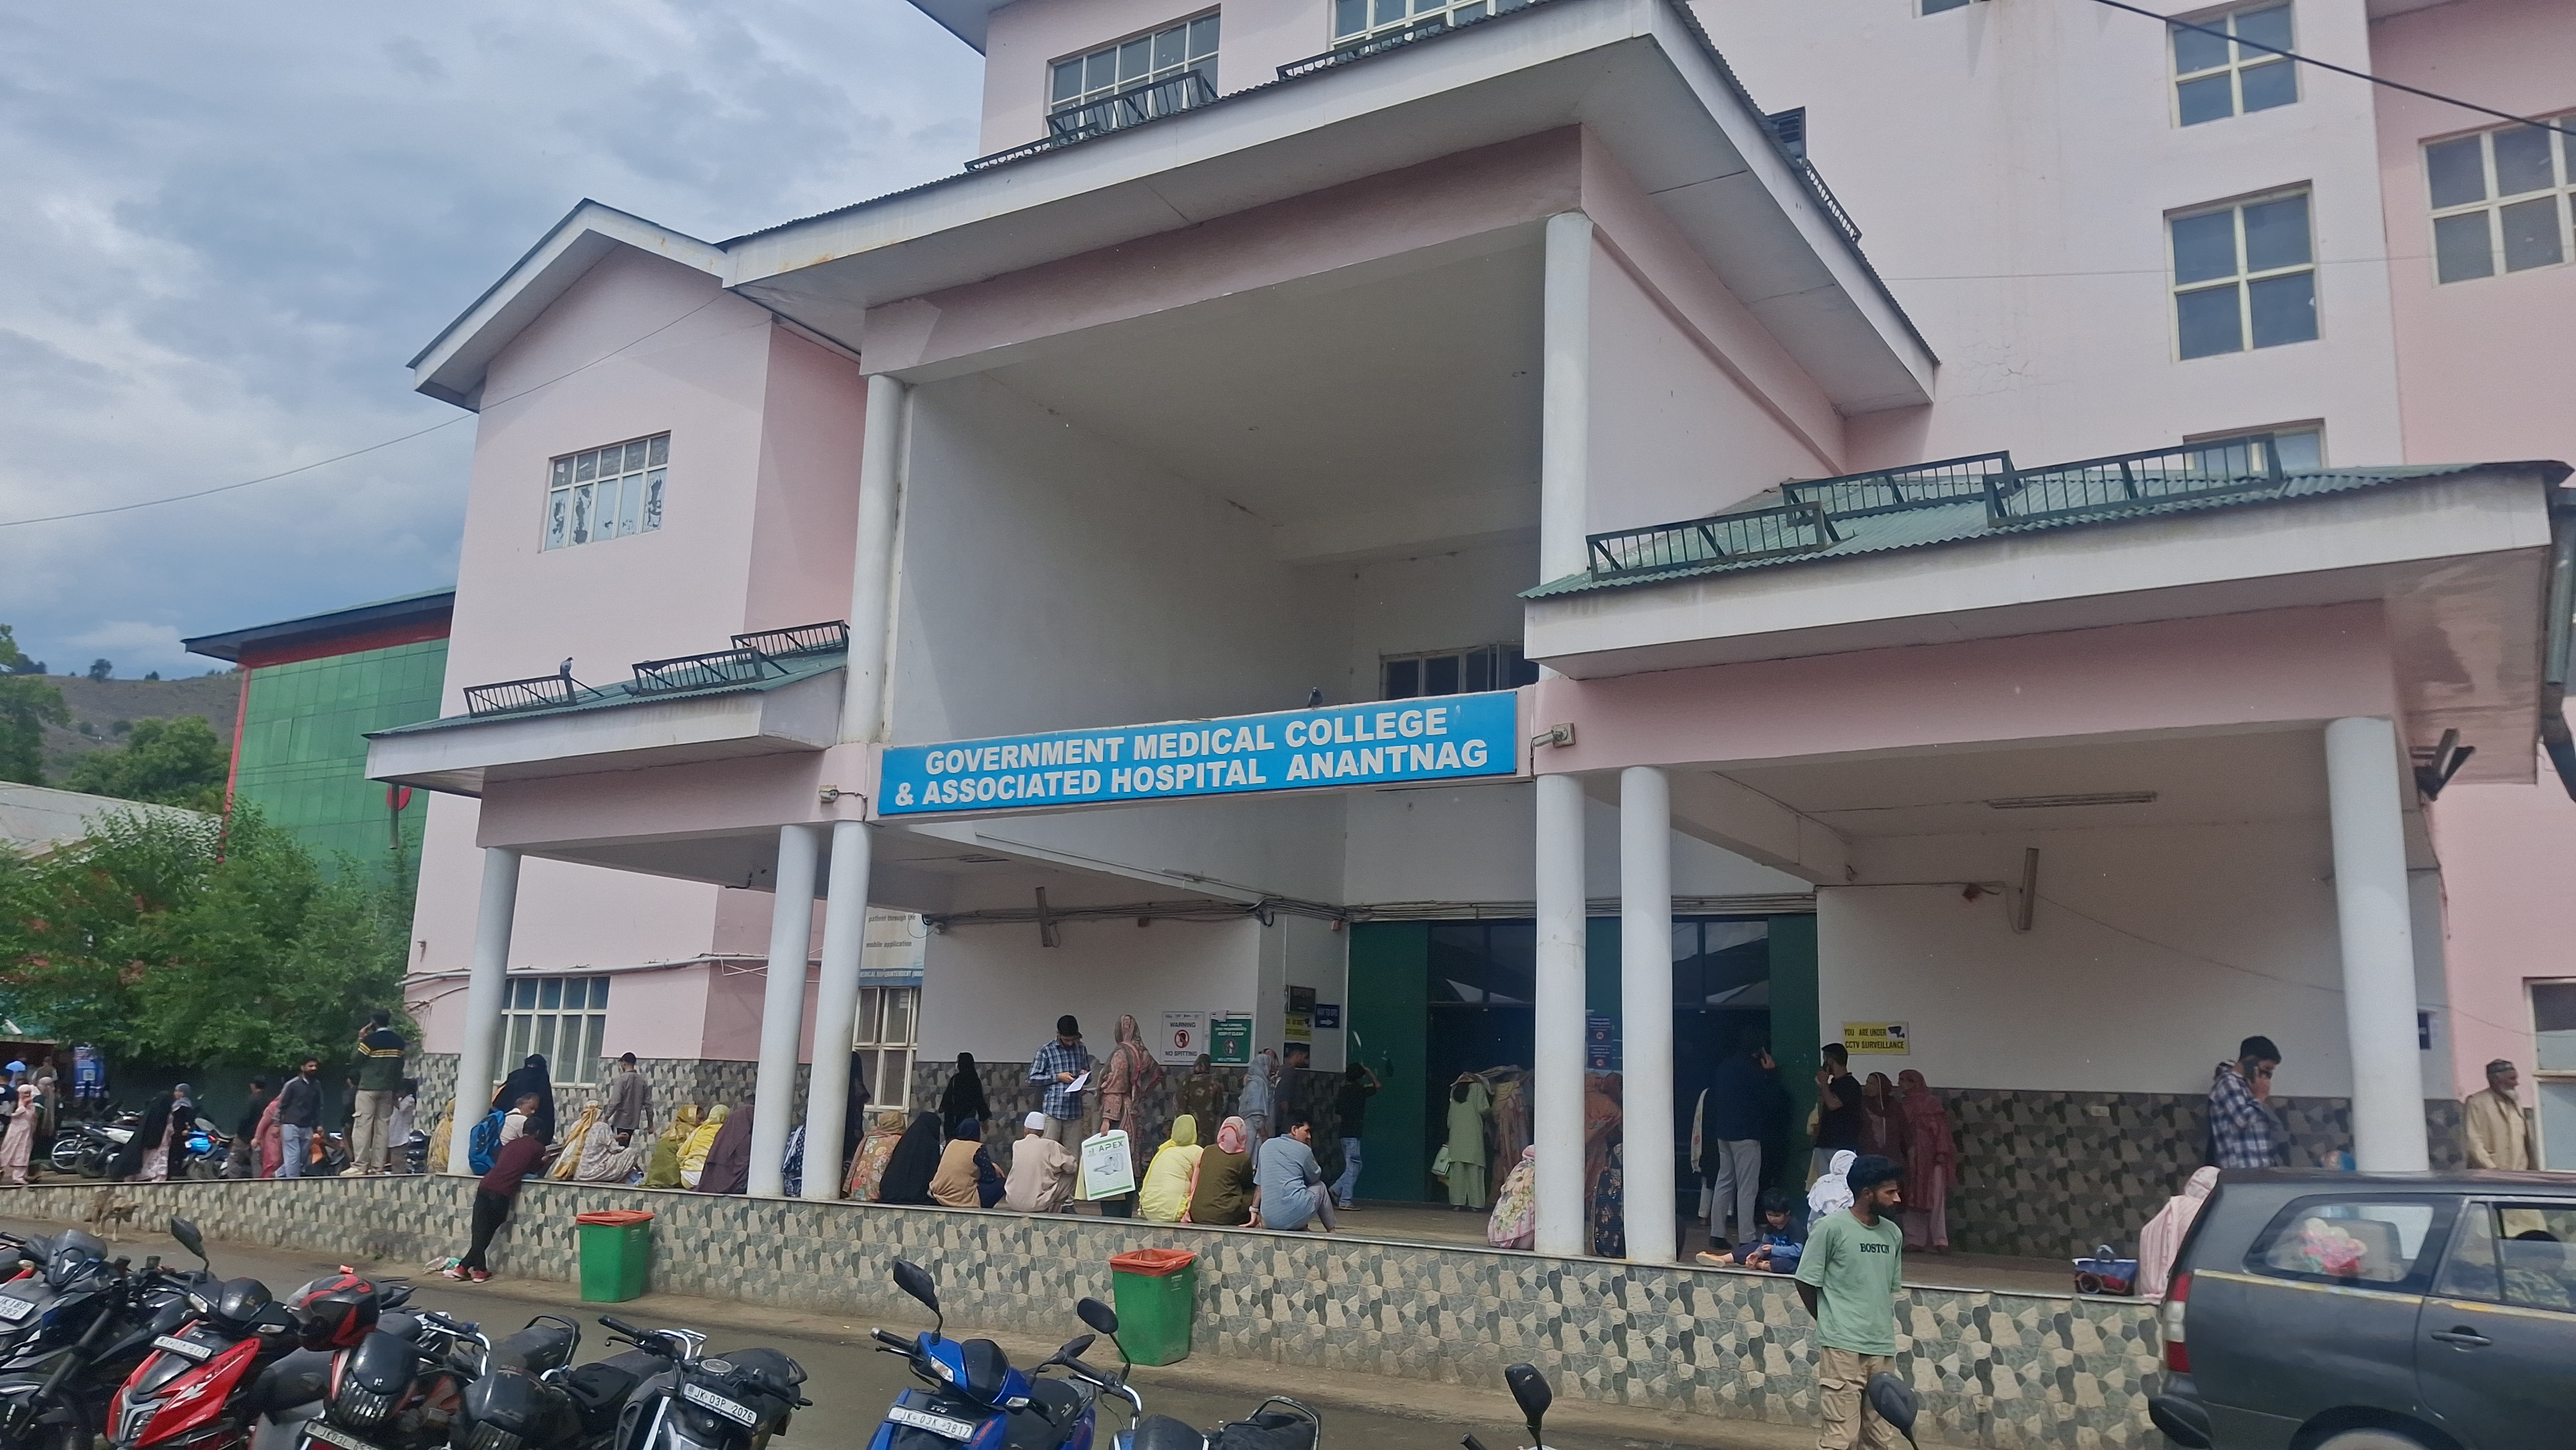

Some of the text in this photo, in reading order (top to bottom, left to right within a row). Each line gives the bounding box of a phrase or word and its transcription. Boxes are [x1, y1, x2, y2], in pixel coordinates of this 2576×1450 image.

[926, 708, 1448, 776] GOVERNMENT MEDICAL COLLEGE
[895, 740, 1488, 806] & ASSOCIATED HOSPITAL ANANTNAG
[884, 940, 912, 949] application
[1844, 1028, 1887, 1036] YOU ARE UNDER
[1845, 1041, 1905, 1049] CCTV SURVEILLANCE
[1099, 1140, 1124, 1153] APEX
[695, 1389, 753, 1422] JK 03P 2076
[930, 1405, 948, 1413] TVS
[900, 1412, 911, 1421] JK
[919, 1415, 938, 1427] 03K
[945, 1422, 972, 1437] 3817
